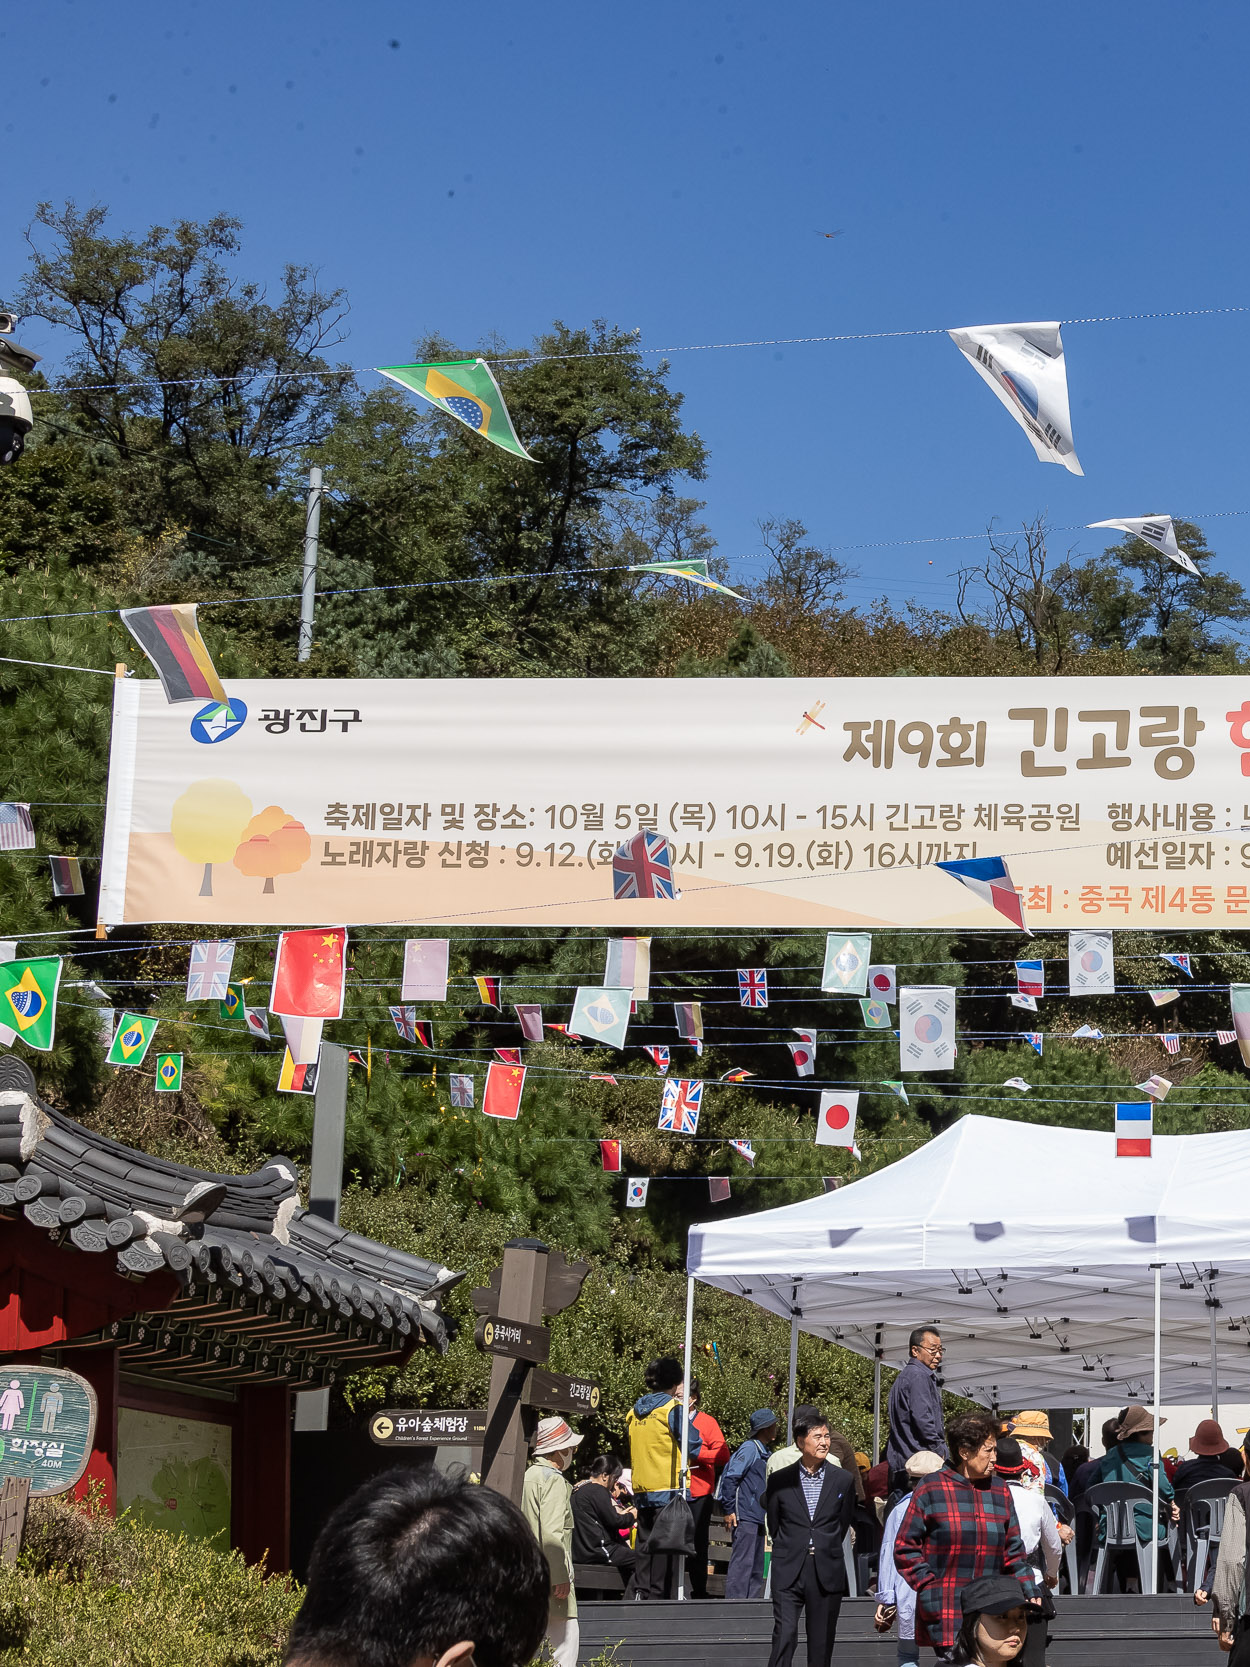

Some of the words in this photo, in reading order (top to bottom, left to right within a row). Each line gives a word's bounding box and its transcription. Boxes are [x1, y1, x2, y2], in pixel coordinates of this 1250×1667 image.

[258, 709, 362, 734] 광진구
[843, 717, 987, 769] 제9회
[1008, 706, 1205, 780] 긴고랑
[324, 802, 431, 830] 축제일자
[441, 803, 464, 831] 및
[474, 803, 535, 831] 장소:
[545, 803, 604, 831] 10월
[615, 803, 658, 832] 5일
[670, 802, 716, 832] (목)
[727, 803, 785, 831] 10시
[817, 803, 874, 831] 15시
[886, 803, 965, 831] 긴고랑
[973, 803, 1080, 831] 체육공원
[1107, 803, 1216, 831] 행사내용
[321, 840, 429, 868] 노래자랑
[438, 840, 489, 868] 신청
[735, 840, 853, 872] 9.19.(화)
[1106, 841, 1215, 870] 예선일자
[1079, 886, 1132, 913] 중곡
[1141, 885, 1215, 914] 제4동
[494, 1324, 521, 1343] 중곡사거리
[570, 1383, 592, 1401] 긴고랑길
[396, 1416, 468, 1432] 유아숲체험장
[10, 1438, 64, 1457] 화장실
[41, 1460, 62, 1468] 40M
